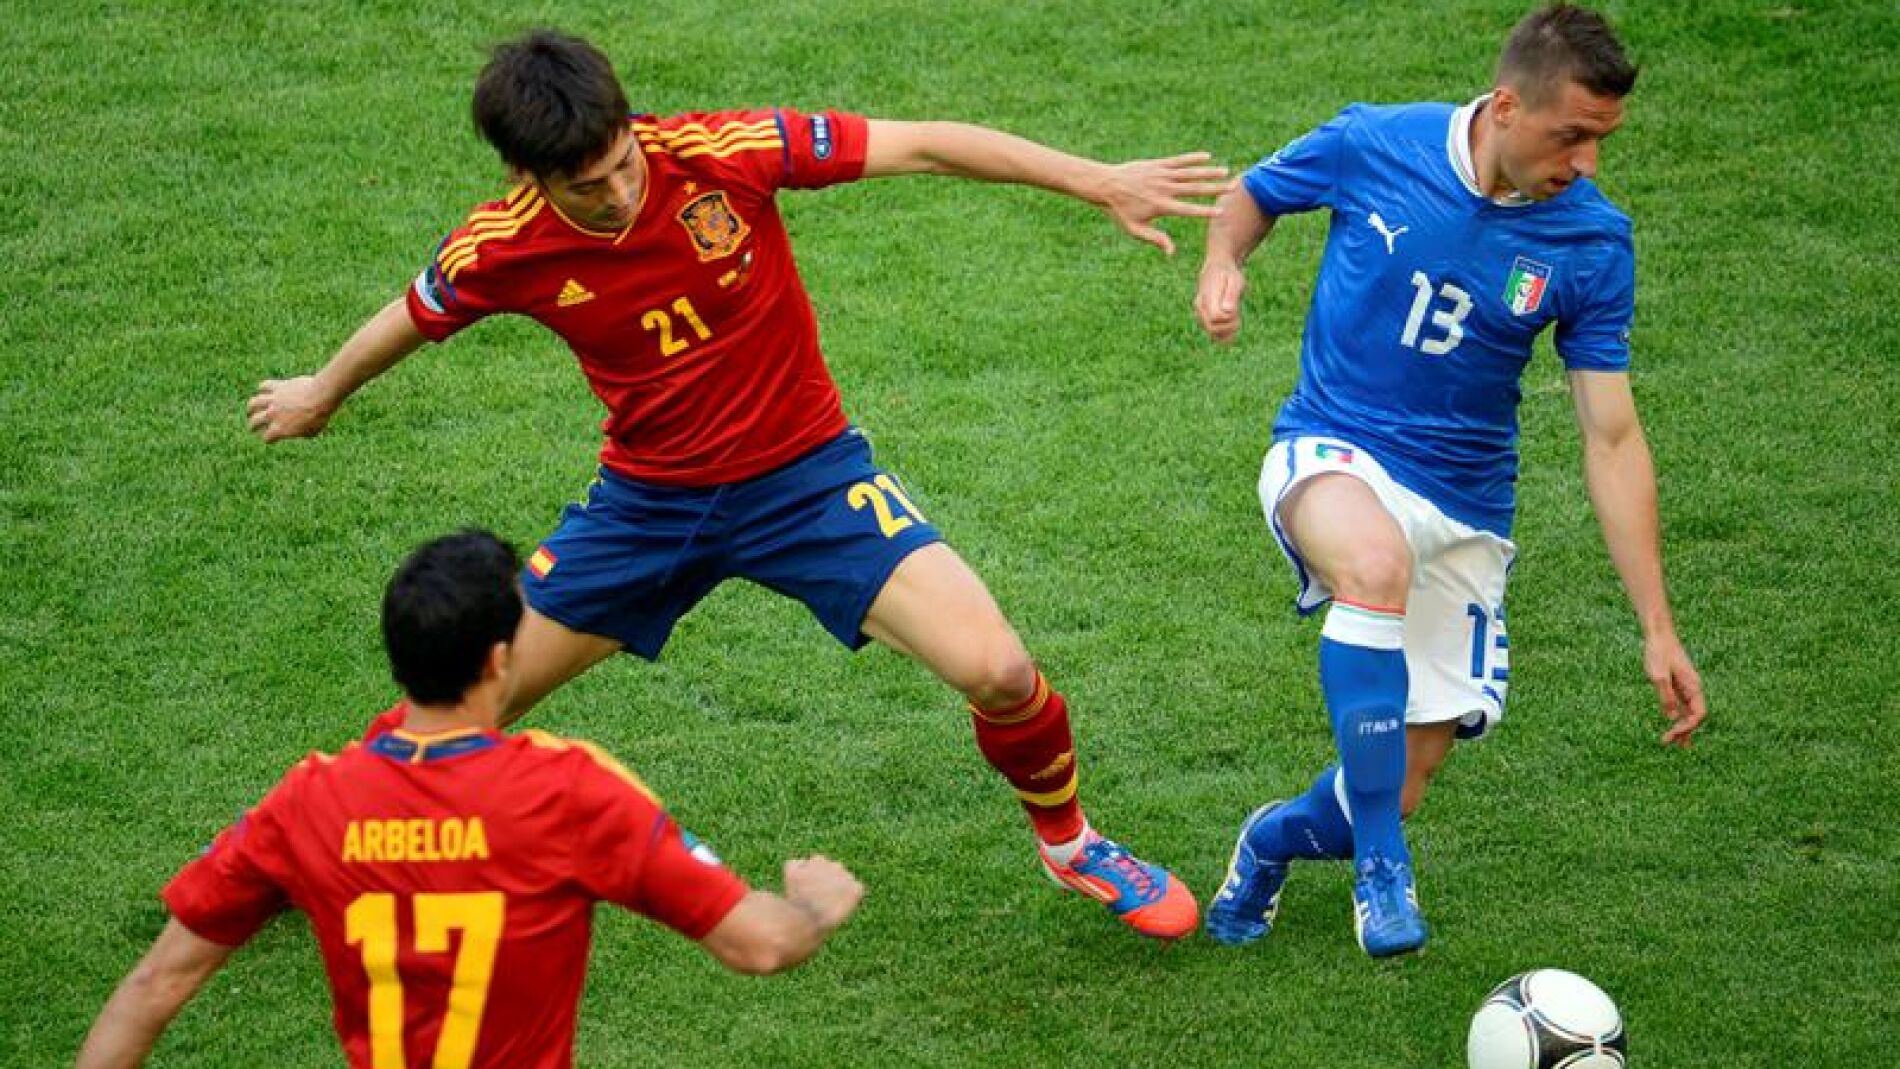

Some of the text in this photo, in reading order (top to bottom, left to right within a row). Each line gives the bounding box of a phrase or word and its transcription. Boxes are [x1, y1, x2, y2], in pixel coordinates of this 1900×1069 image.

[641, 296, 713, 357] 21
[1400, 270, 1474, 355] 13
[847, 474, 927, 537] 21
[343, 817, 488, 861] ARBELOA
[344, 890, 506, 1069] 17
